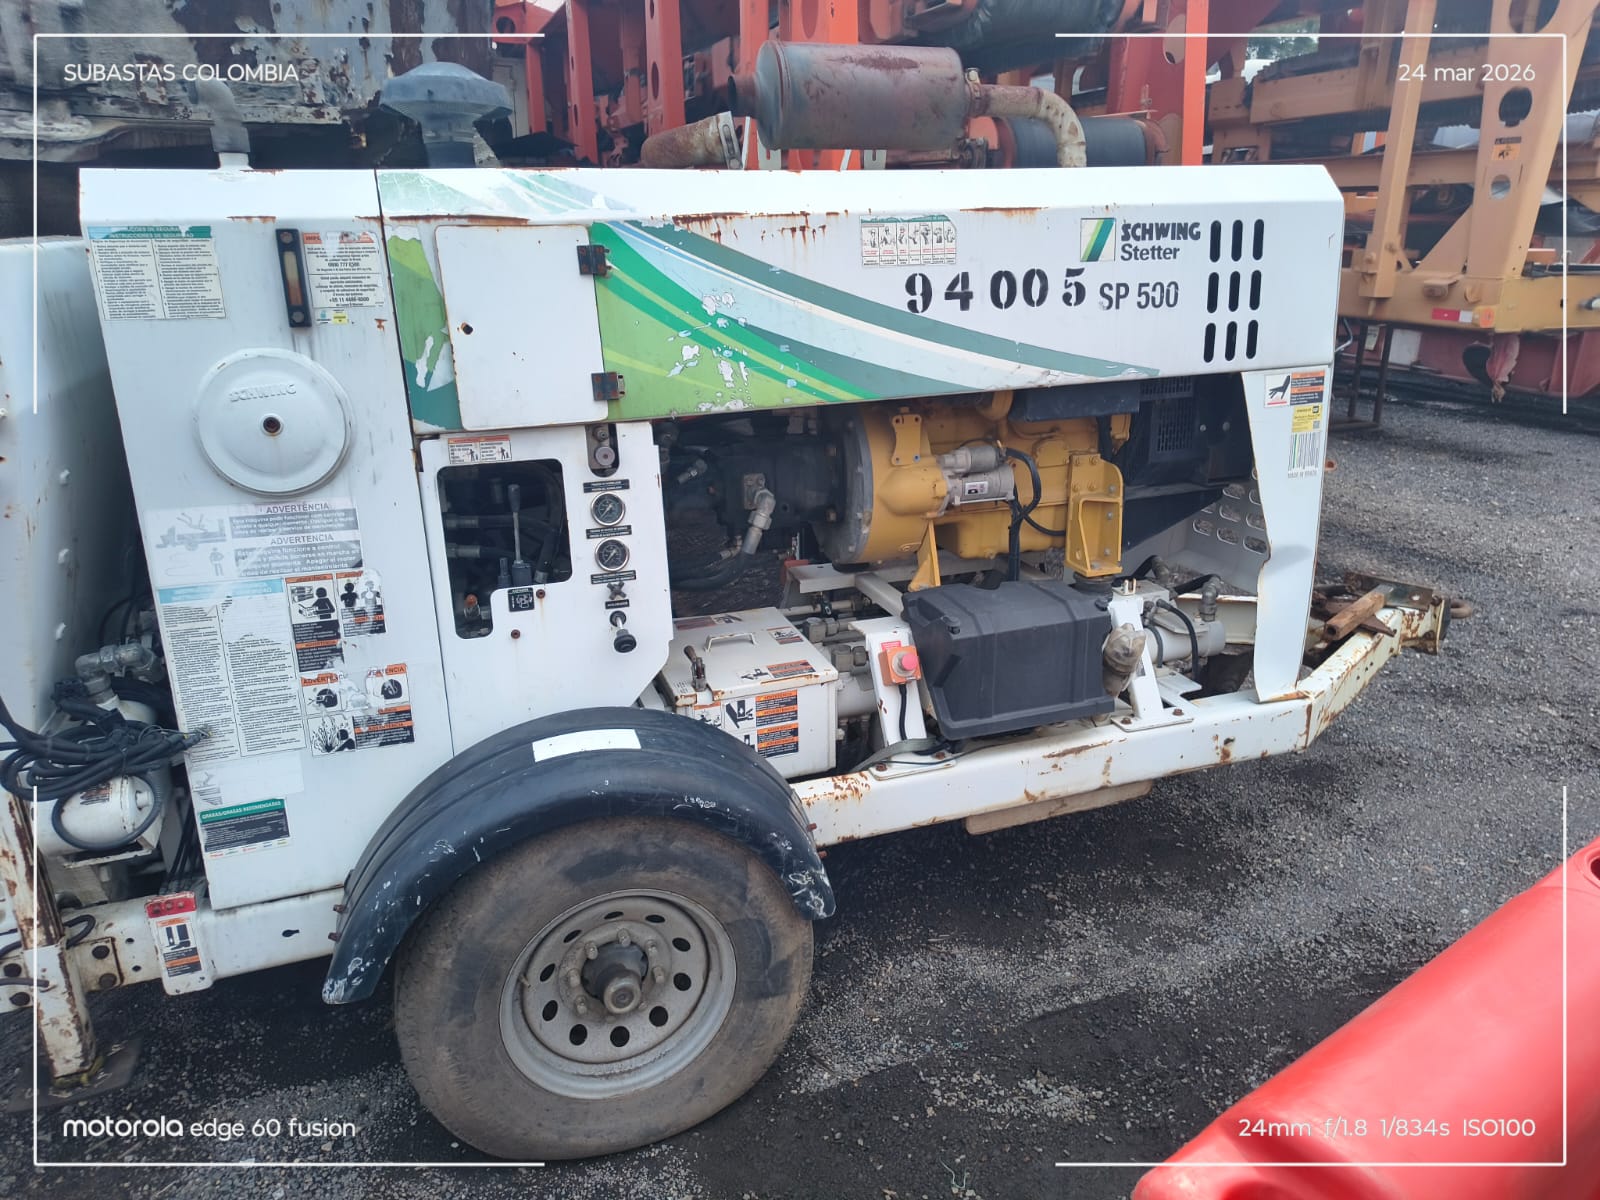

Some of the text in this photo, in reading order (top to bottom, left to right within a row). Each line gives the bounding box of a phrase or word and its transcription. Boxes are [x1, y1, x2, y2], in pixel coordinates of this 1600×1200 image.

[1121, 222, 1201, 242] SCHWING
[1120, 243, 1180, 262] Stetter
[1099, 280, 1180, 311] SP 500
[270, 533, 335, 546] ADVERTENCIA
